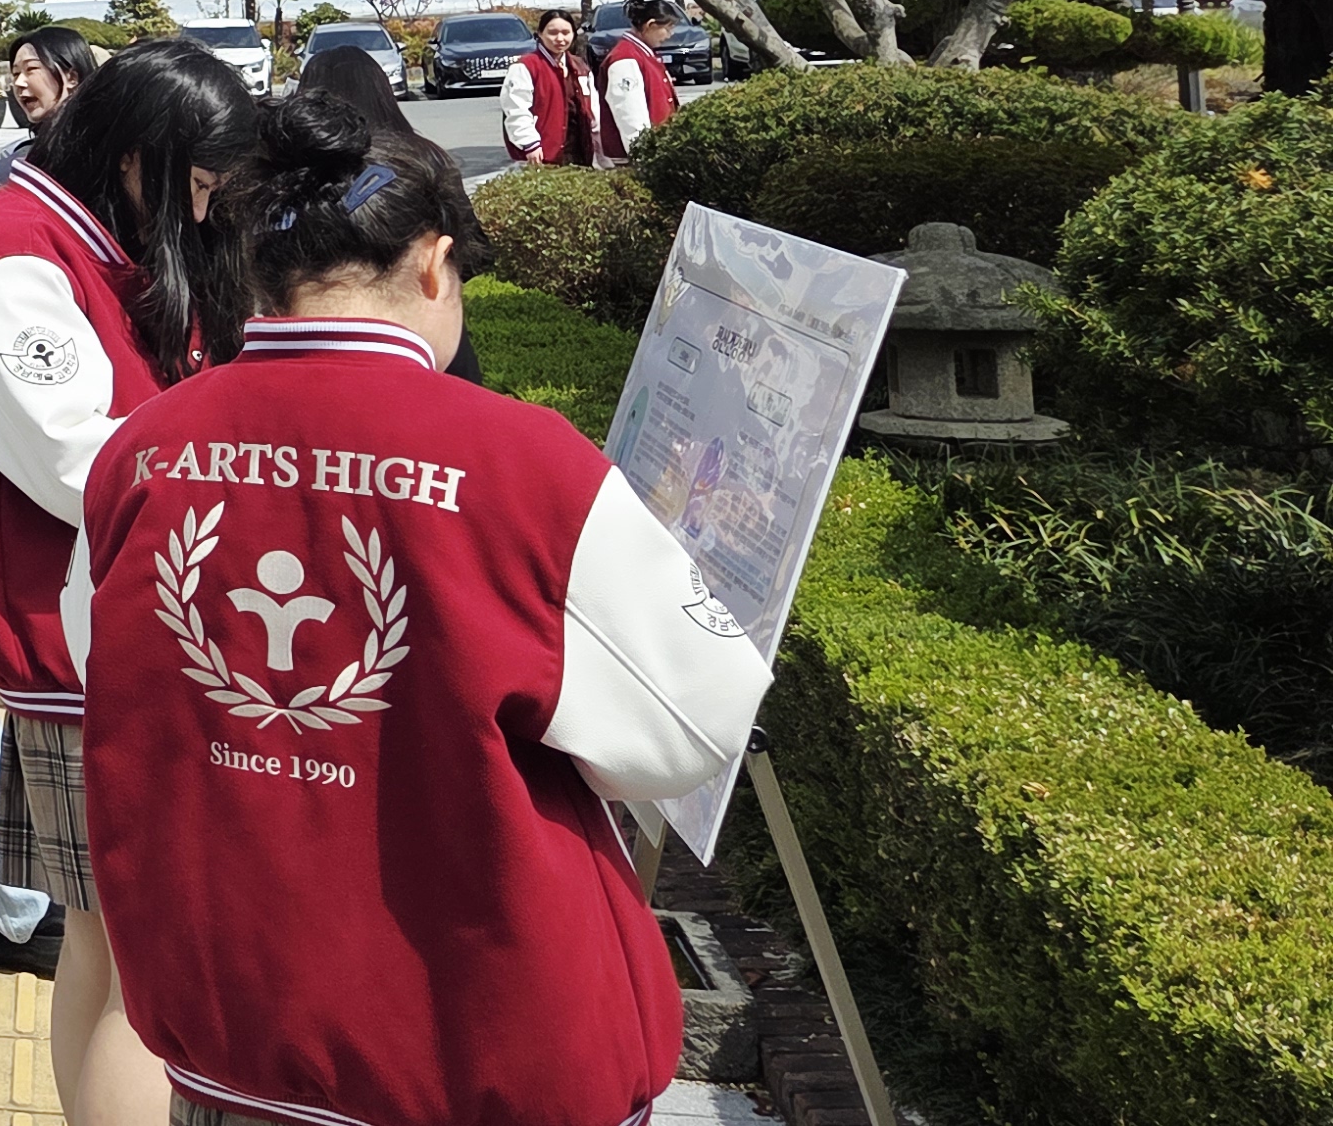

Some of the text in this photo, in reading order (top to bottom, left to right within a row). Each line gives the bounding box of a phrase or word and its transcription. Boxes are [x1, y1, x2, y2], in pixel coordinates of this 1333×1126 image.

[131, 441, 466, 513] K-ARTS HIGH
[209, 741, 356, 788] Since 1990
